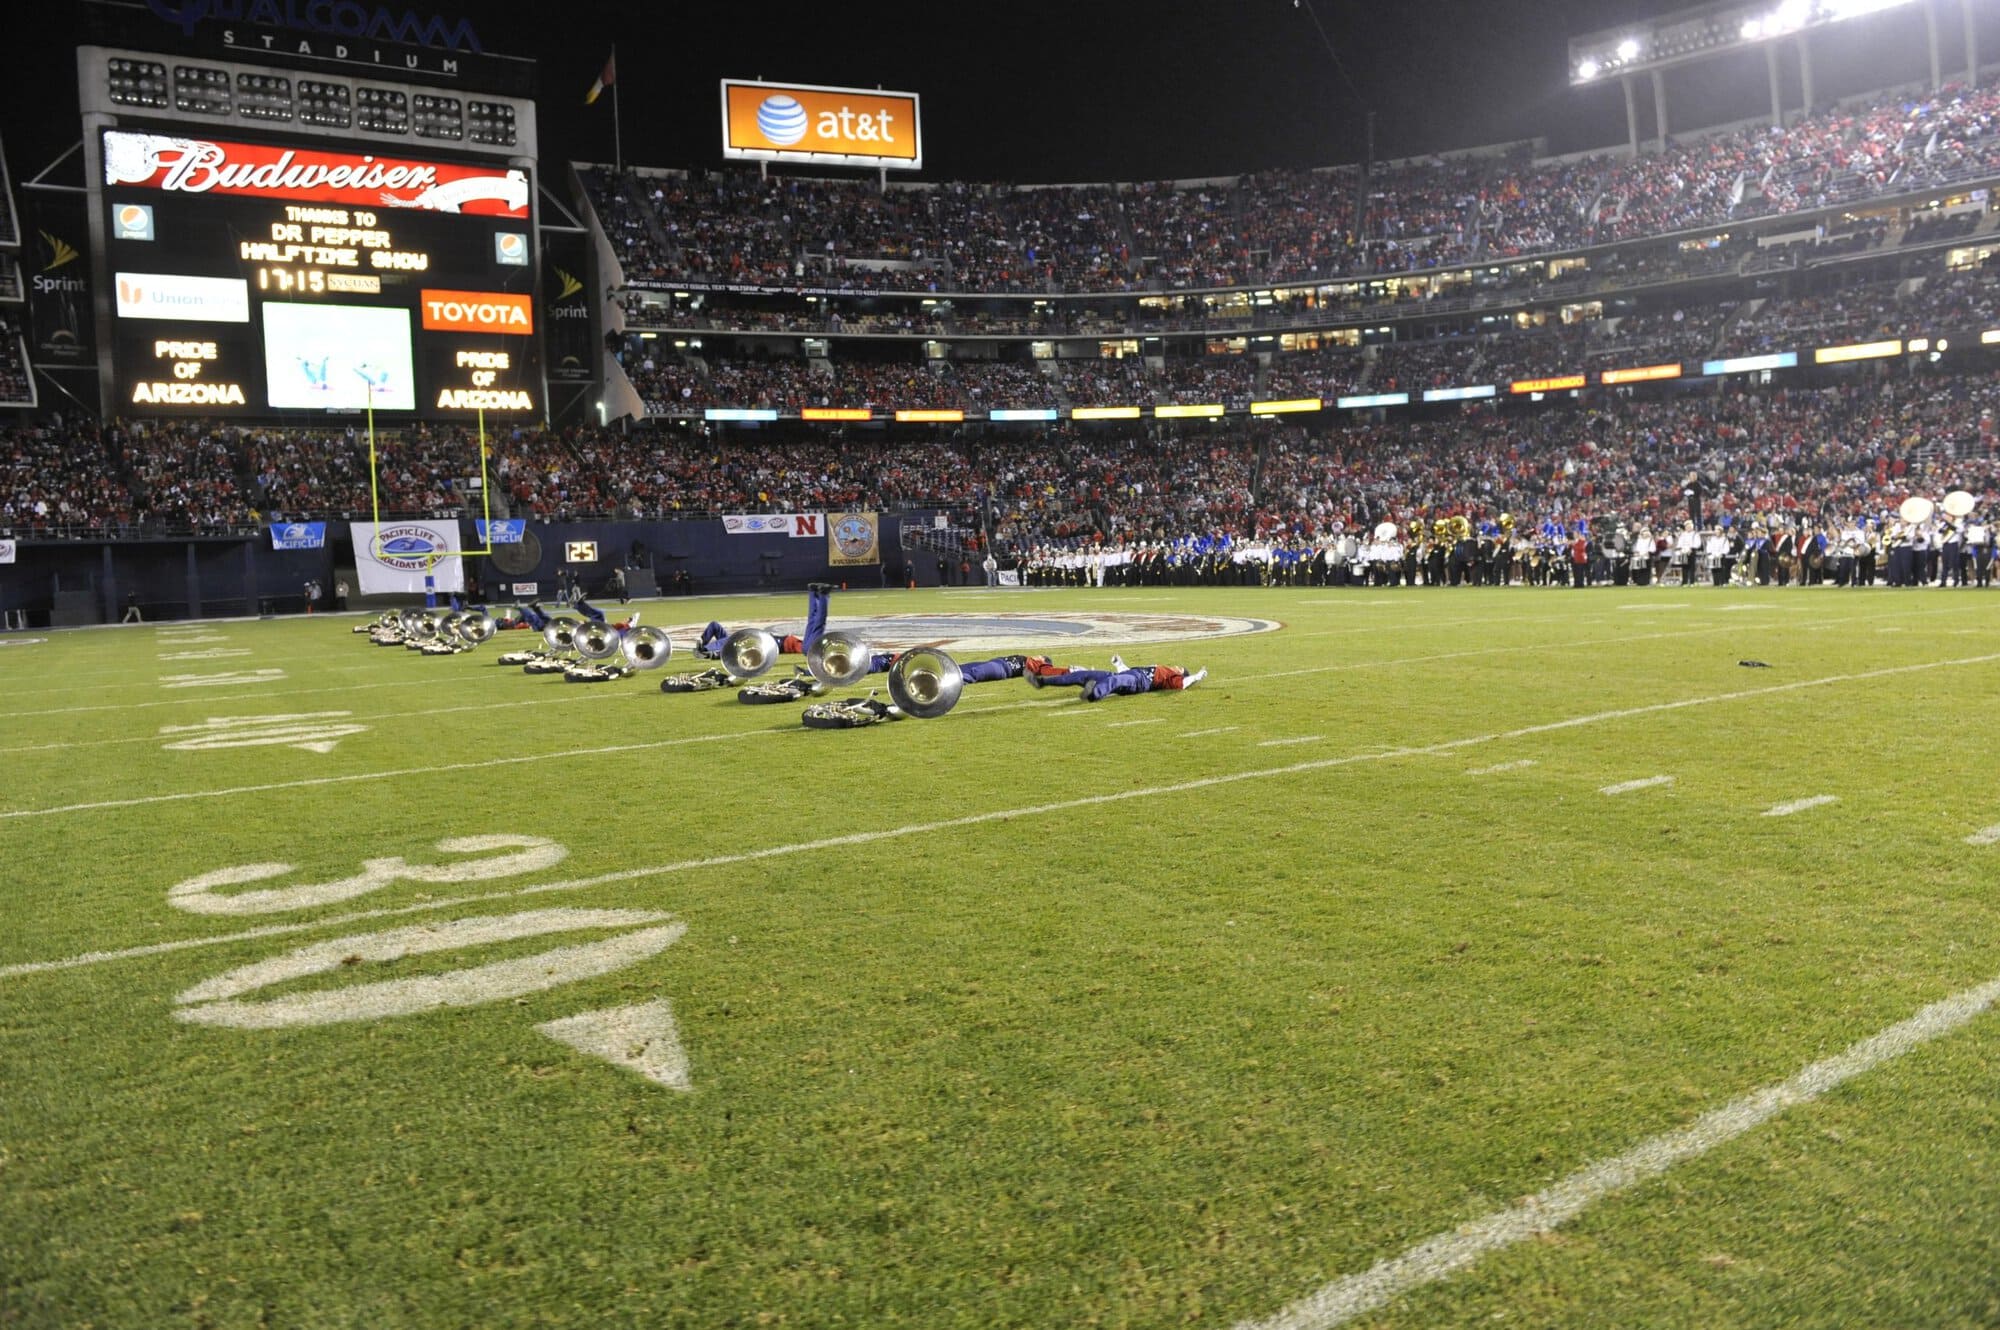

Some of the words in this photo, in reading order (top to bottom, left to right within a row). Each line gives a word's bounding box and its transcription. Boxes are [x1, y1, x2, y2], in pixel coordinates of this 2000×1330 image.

[223, 30, 458, 73] STADIUM
[816, 106, 894, 143] at&t
[152, 140, 436, 193] Budweiser
[285, 206, 349, 225] THANKS
[354, 212, 377, 227] TO
[271, 223, 303, 242] DR
[311, 227, 391, 248] PEPPER
[241, 242, 359, 266] HALFTIME
[371, 251, 428, 271] SHOW
[33, 275, 86, 293] Sprint
[259, 268, 324, 292] 17:15
[152, 291, 204, 305] Union
[427, 301, 528, 325] TOYOTA
[548, 303, 588, 319] Sprint
[155, 341, 217, 359] PRIDE
[174, 362, 201, 379] OF
[456, 352, 509, 369] PRIDE
[472, 371, 496, 387] OF
[133, 382, 246, 405] ARIZONA
[437, 389, 533, 410] ARIZONA
[379, 528, 414, 542] PACIFIC
[415, 529, 435, 541] LIFE
[795, 516, 817, 535] N
[569, 543, 594, 560] 25
